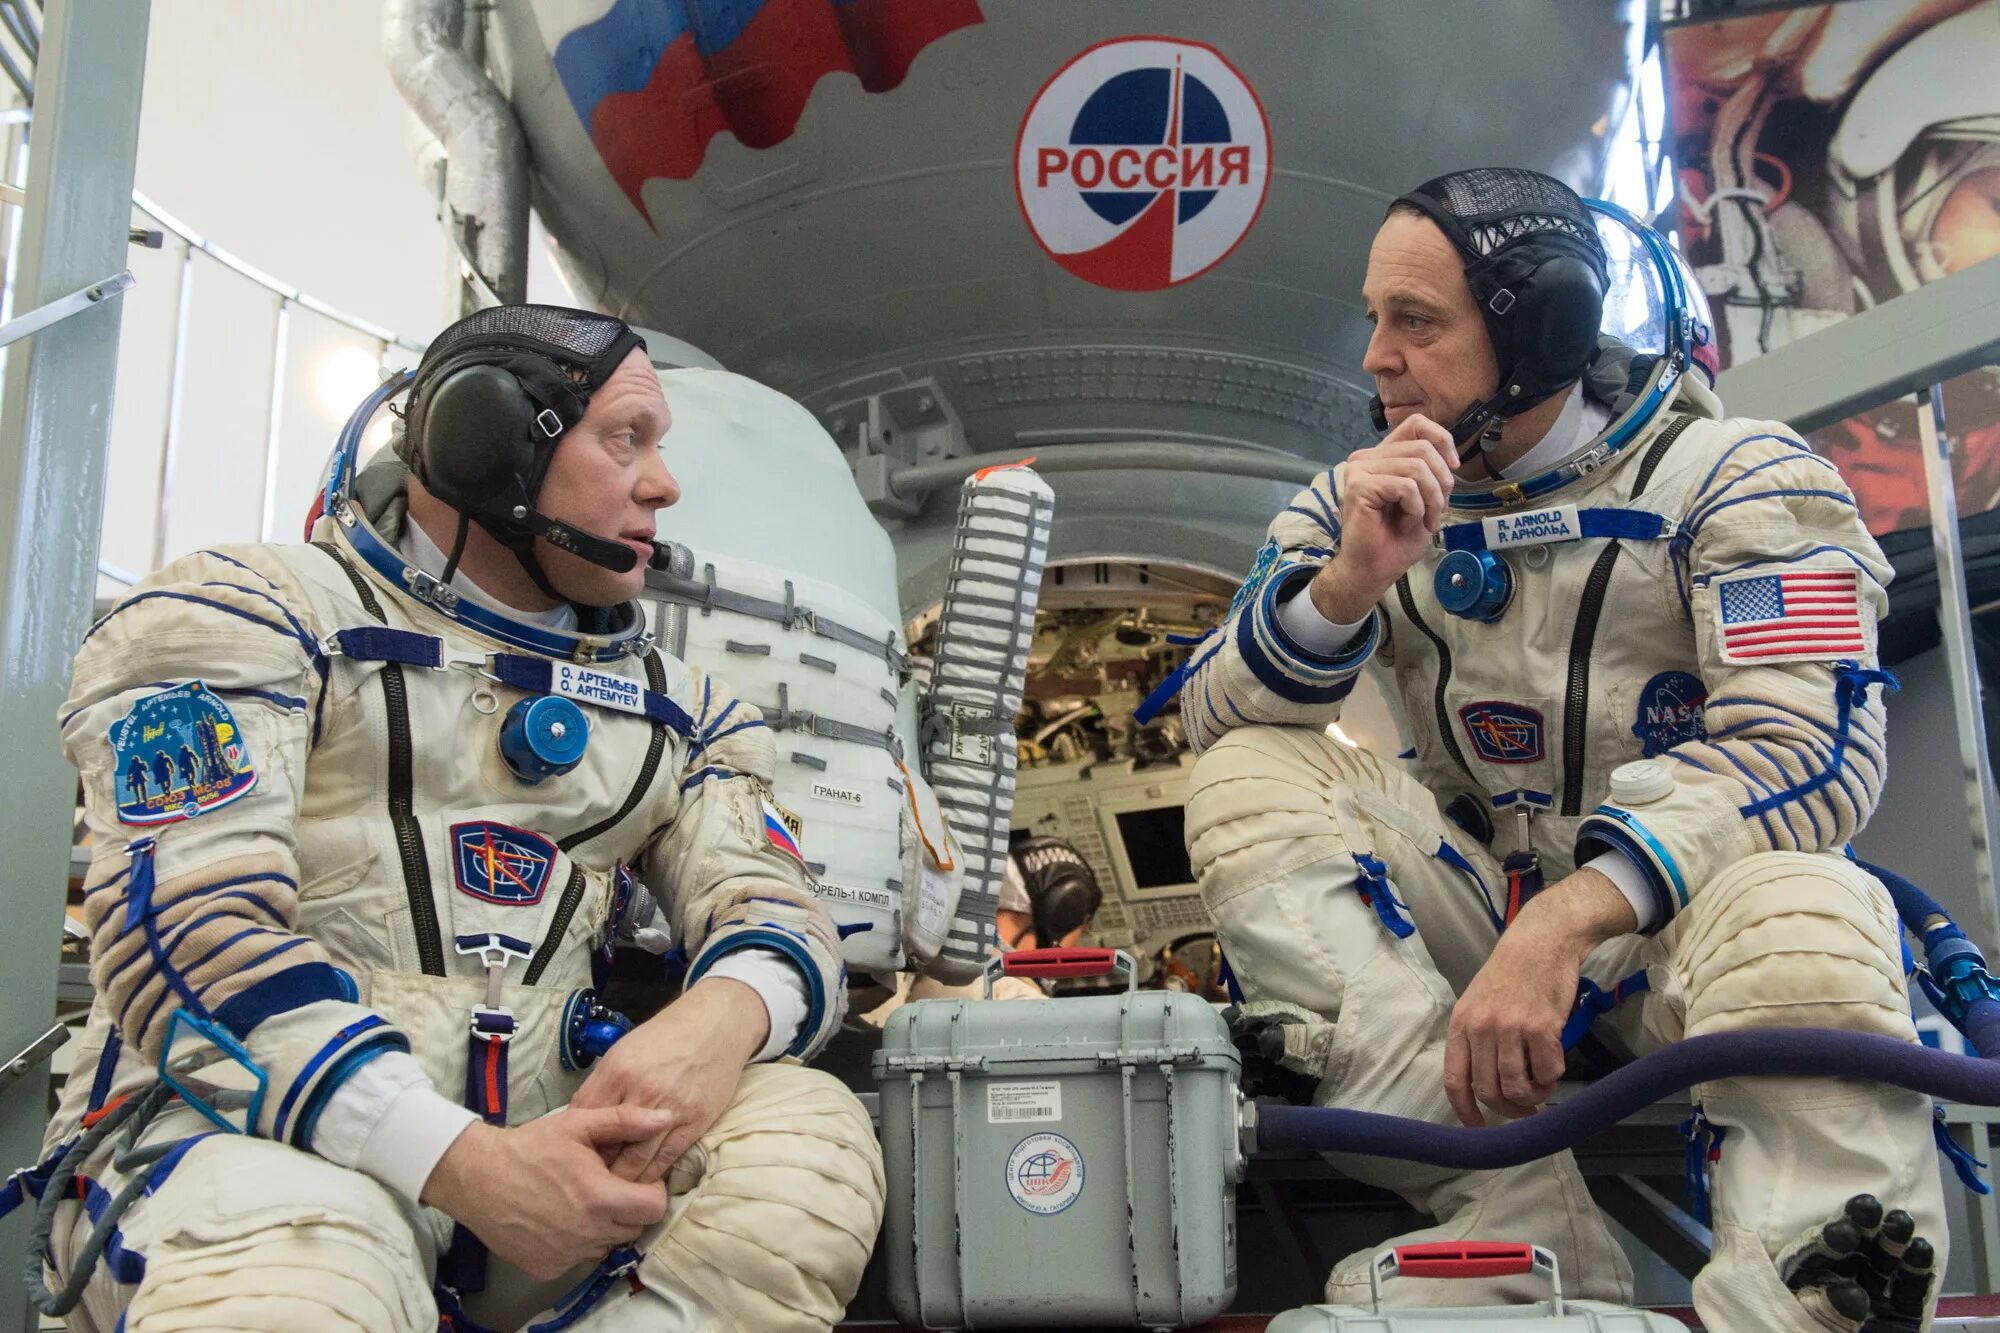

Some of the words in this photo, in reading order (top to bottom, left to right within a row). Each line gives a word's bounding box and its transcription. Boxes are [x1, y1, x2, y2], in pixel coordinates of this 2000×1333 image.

[1037, 146, 1250, 189] РОССИЯ
[1498, 520, 1509, 531] R.
[1514, 511, 1562, 528] ARNOLD
[1511, 523, 1570, 541] АРНОЛЬД
[578, 671, 638, 695] АРТЕМЬЕВ
[141, 690, 191, 711] АРТЕМЬЕВ
[198, 693, 229, 720] ARNOLD
[577, 684, 638, 707] ARTEMYEV
[1646, 705, 1704, 724] NASA
[117, 714, 138, 752] FEUSTEL
[146, 791, 186, 809] СОЮЗ
[193, 777, 232, 796] МС-08
[813, 784, 862, 803] ГРАНАТ-6
[164, 801, 184, 812] МКС
